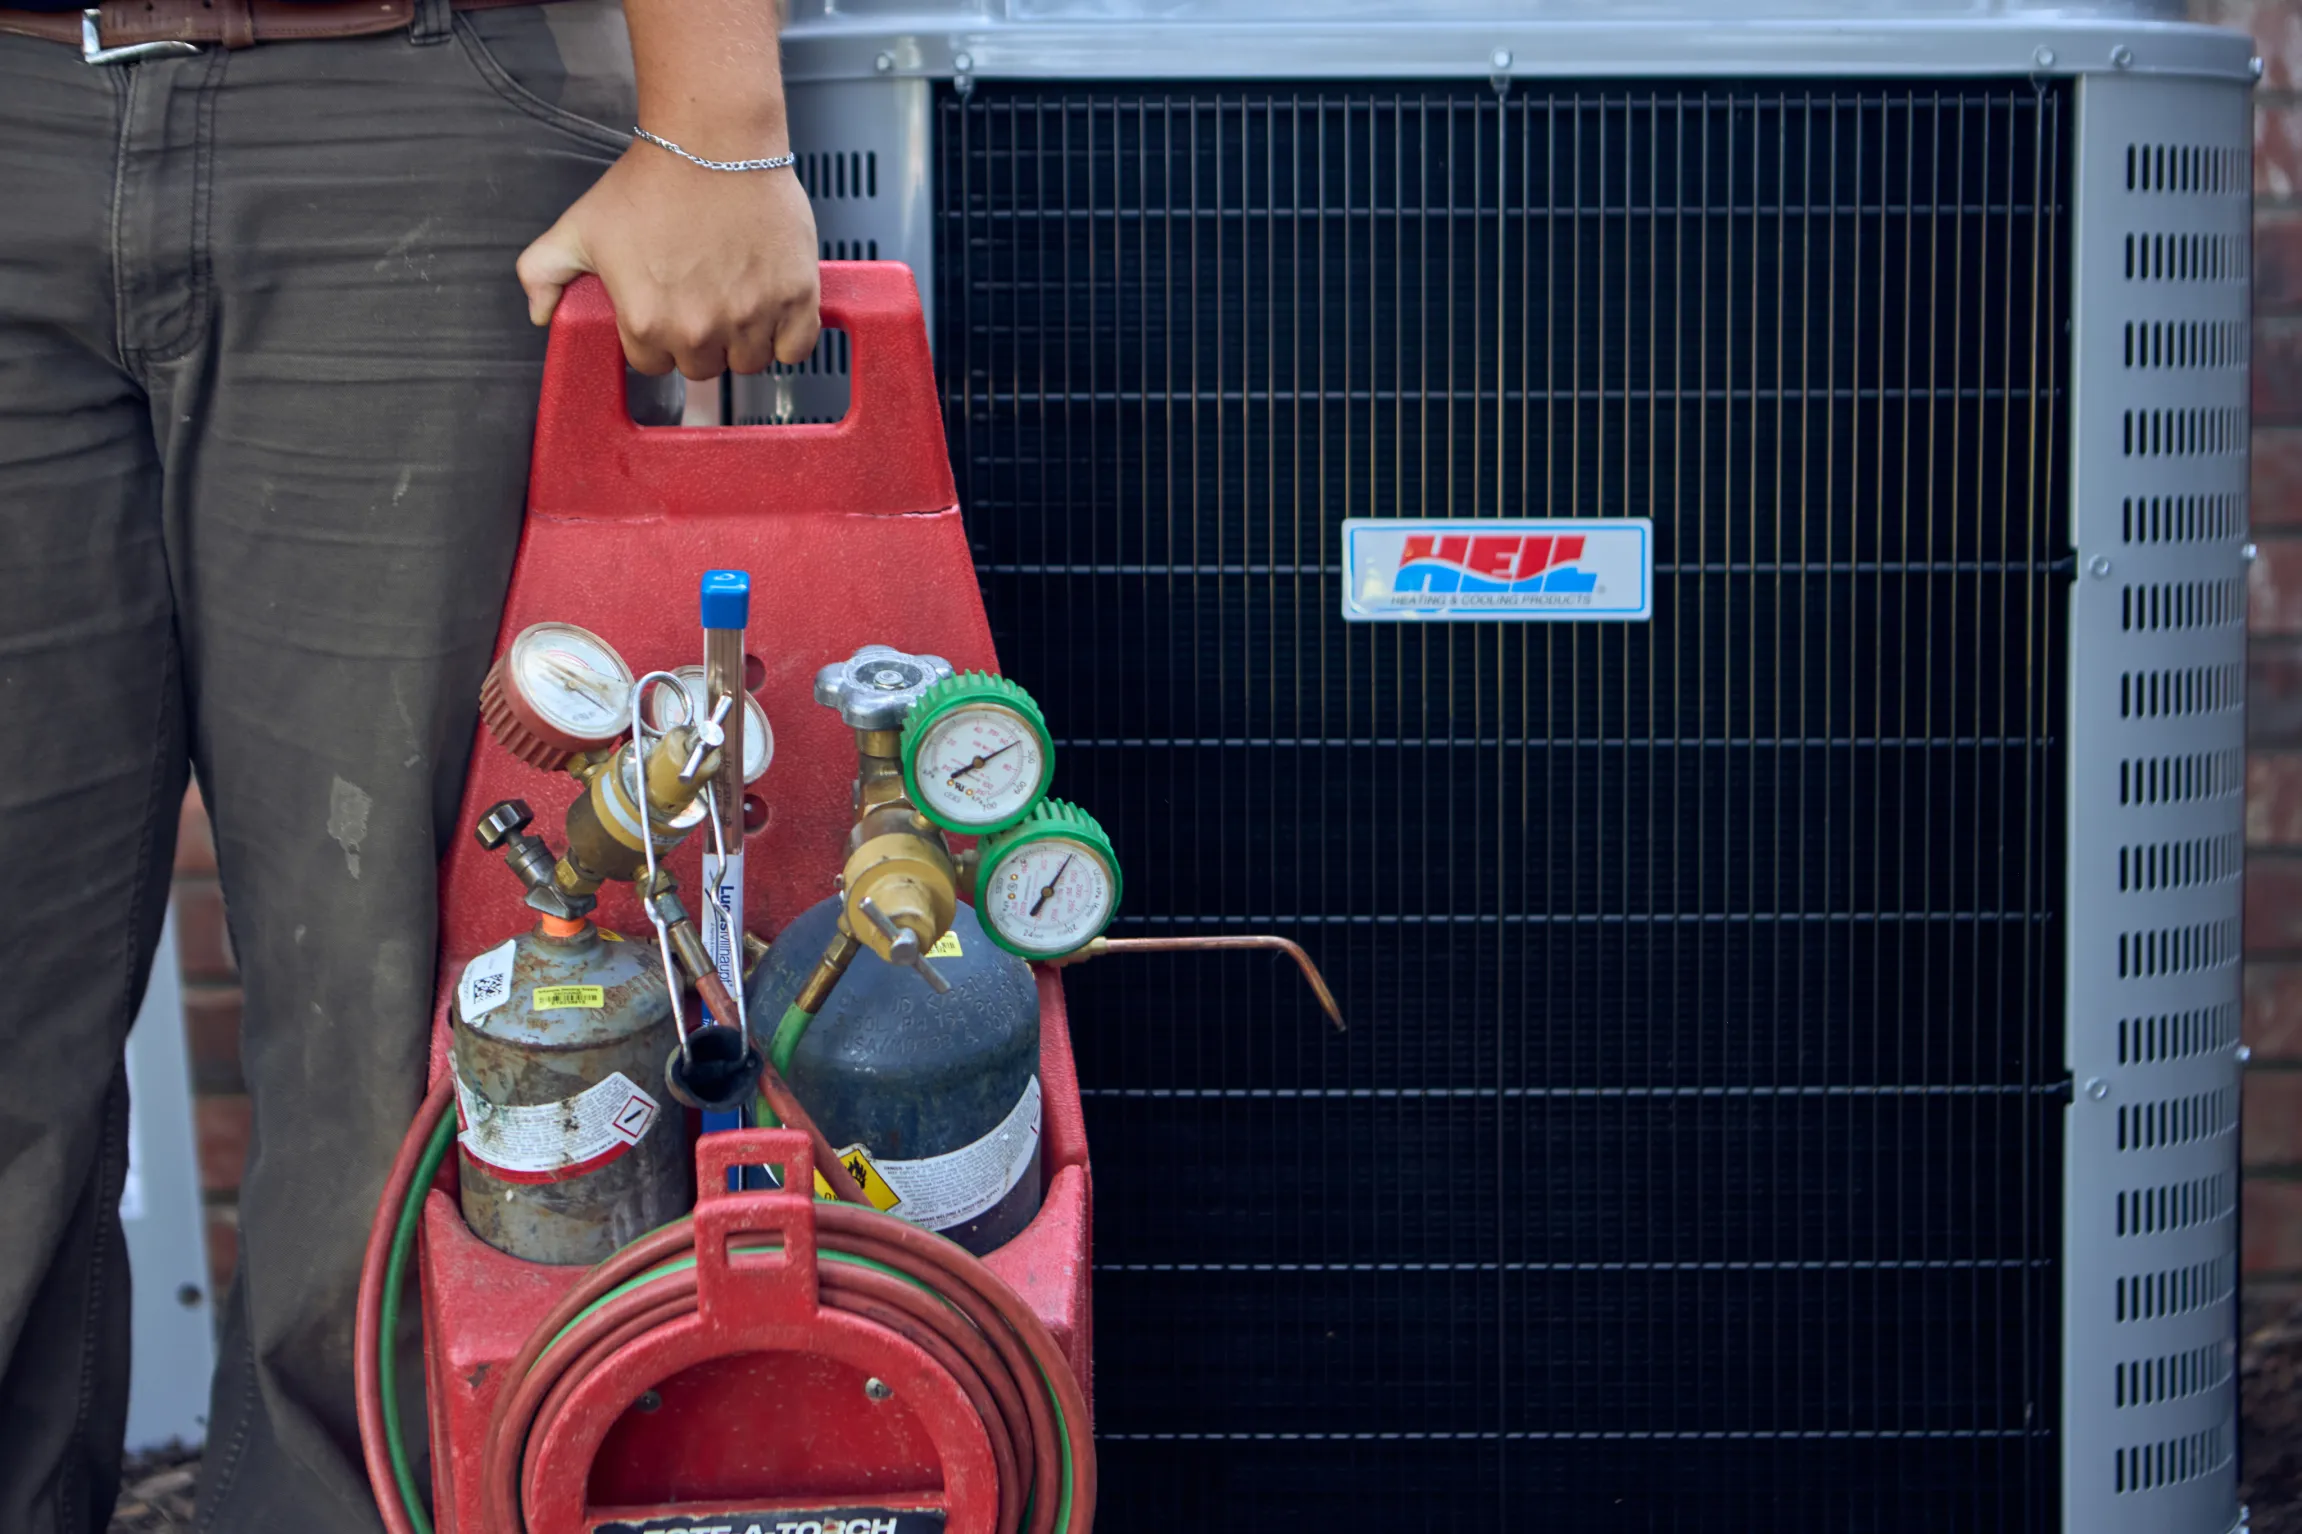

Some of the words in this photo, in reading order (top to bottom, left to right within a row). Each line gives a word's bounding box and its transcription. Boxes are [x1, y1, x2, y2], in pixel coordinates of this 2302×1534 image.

[1393, 535, 1598, 593] HEIL
[1390, 595, 1446, 606] HEATING
[1461, 595, 1519, 606] COOLING
[1521, 595, 1592, 606] PRODUCTS
[718, 886, 735, 984] LucsMilhaupt
[643, 1516, 898, 1534] -A-TOCH
